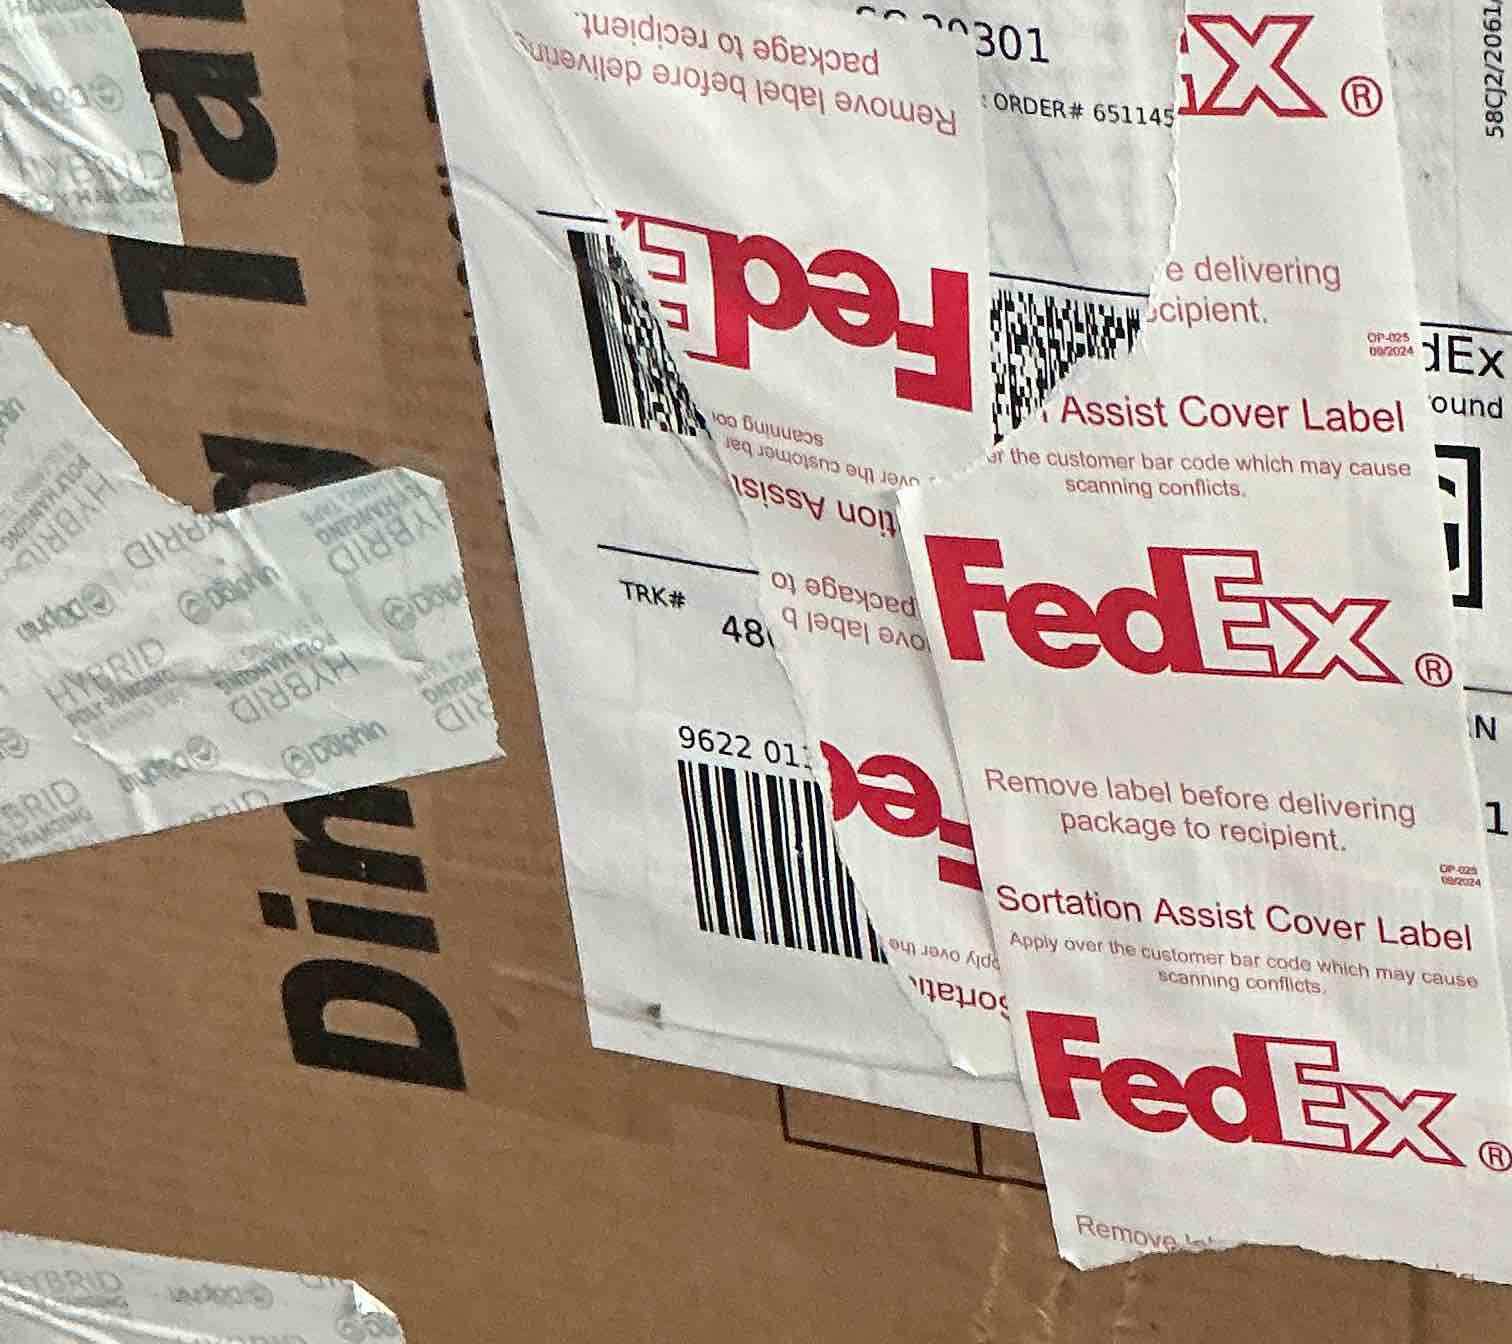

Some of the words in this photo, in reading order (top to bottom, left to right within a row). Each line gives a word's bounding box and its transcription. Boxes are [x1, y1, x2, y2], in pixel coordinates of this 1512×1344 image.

[576, 9, 713, 50] recipient.
[717, 31, 748, 54] to
[922, 13, 1051, 65] 301
[752, 38, 880, 77] package
[652, 62, 747, 99] before
[754, 77, 826, 113] label
[834, 90, 958, 136] Remove
[993, 91, 1084, 120] ORDER#
[1092, 102, 1175, 129] 651145
[1193, 256, 1342, 292] delivering
[615, 209, 974, 412] FedE
[1060, 394, 1168, 429] Assist
[1179, 396, 1289, 431] Cover
[1302, 398, 1405, 434] Label
[725, 434, 754, 457] bar
[756, 441, 840, 475] customer
[845, 463, 878, 484] the
[1010, 449, 1041, 467] the
[1046, 450, 1134, 472] customer
[1141, 451, 1173, 472] bar
[1180, 453, 1231, 473] code
[1235, 454, 1294, 477] which
[1300, 458, 1342, 481] may
[1348, 460, 1412, 478] cause
[1064, 477, 1153, 500] scanning
[1158, 478, 1247, 499] conflicts.
[619, 579, 686, 608] TRK#
[771, 570, 802, 595] to
[806, 610, 872, 643] label
[924, 533, 1404, 685] FedEx
[230, 651, 361, 725] HYBRID
[677, 724, 752, 760] 9622
[983, 766, 1099, 799] Remove
[1105, 776, 1172, 805] label
[1181, 783, 1274, 815] before
[1279, 790, 1417, 829] delivering
[1060, 811, 1177, 842] package
[1184, 817, 1212, 841] to
[1219, 820, 1347, 855] recipient.
[995, 884, 1143, 924] Sortation
[1153, 897, 1257, 932] Assist
[1265, 905, 1366, 942] Cover
[1378, 914, 1473, 953] Label
[1008, 931, 1058, 953] Apply
[1064, 936, 1103, 954] over
[1101, 940, 1137, 957] the
[1140, 944, 1225, 968] customer
[1230, 949, 1262, 970] bar
[1266, 955, 1311, 972] code
[1317, 955, 1370, 980] which
[1375, 962, 1416, 986] may
[1421, 971, 1479, 990] cause
[1157, 968, 1240, 993] scanning
[1026, 1009, 1468, 1168] FedEx
[1075, 1212, 1178, 1252] Remove
